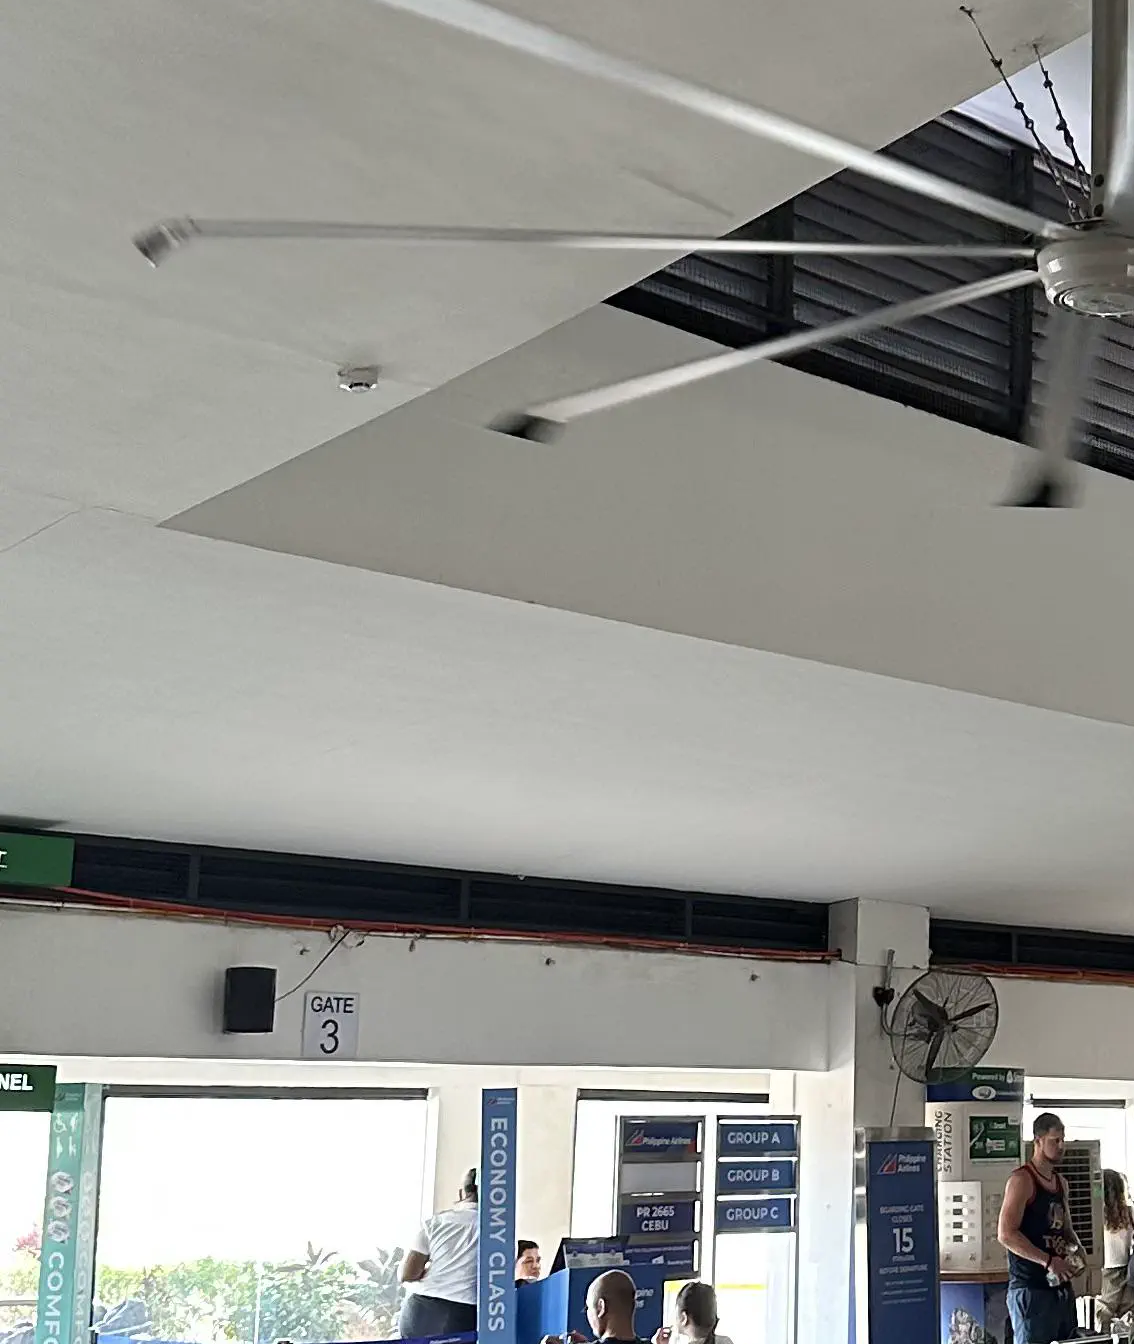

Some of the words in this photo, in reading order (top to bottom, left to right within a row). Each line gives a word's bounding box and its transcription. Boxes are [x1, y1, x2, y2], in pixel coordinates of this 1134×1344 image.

[311, 996, 354, 1013] GATE
[320, 1019, 339, 1054] 3
[727, 1132, 769, 1144] GROUP
[771, 1132, 780, 1144] A
[944, 1112, 953, 1173] STATION
[489, 1117, 508, 1244] ECONOMY
[727, 1169, 769, 1182] GROUP
[771, 1169, 780, 1181] B
[636, 1206, 650, 1218] PR
[726, 1207, 768, 1221] GROUP
[770, 1206, 778, 1219] C
[641, 1219, 669, 1232] CEBU
[892, 1227, 914, 1253] 15
[487, 1251, 506, 1332] CLASS
